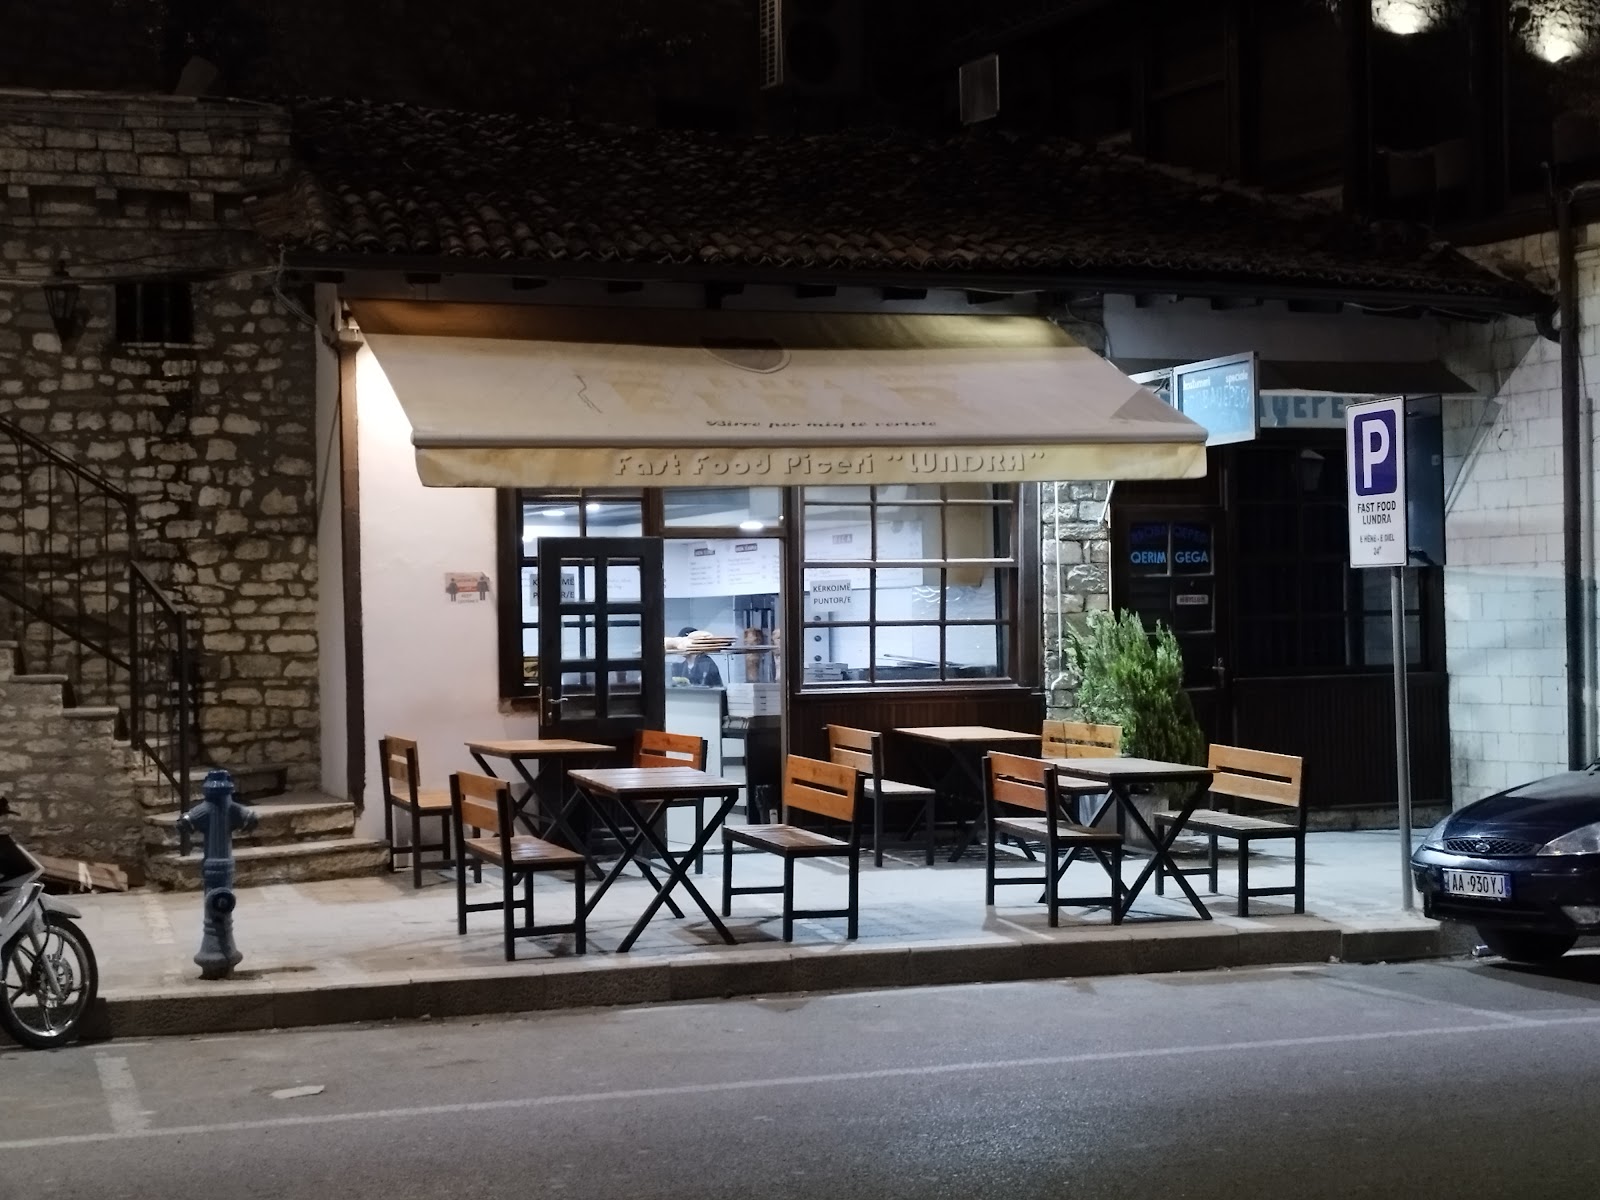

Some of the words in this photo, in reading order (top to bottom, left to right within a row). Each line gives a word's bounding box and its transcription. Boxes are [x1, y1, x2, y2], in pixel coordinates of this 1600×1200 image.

[1361, 418, 1390, 489] P
[614, 454, 681, 476] Fast
[692, 453, 772, 476] Food
[1357, 502, 1375, 513] FAST
[1376, 500, 1397, 512] FOOD
[1362, 513, 1392, 525] LUNDRA
[1130, 551, 1167, 564] QERIM
[1174, 550, 1209, 563] GEGA
[813, 596, 852, 605] PUNTOR/E
[1452, 873, 1465, 891] AA
